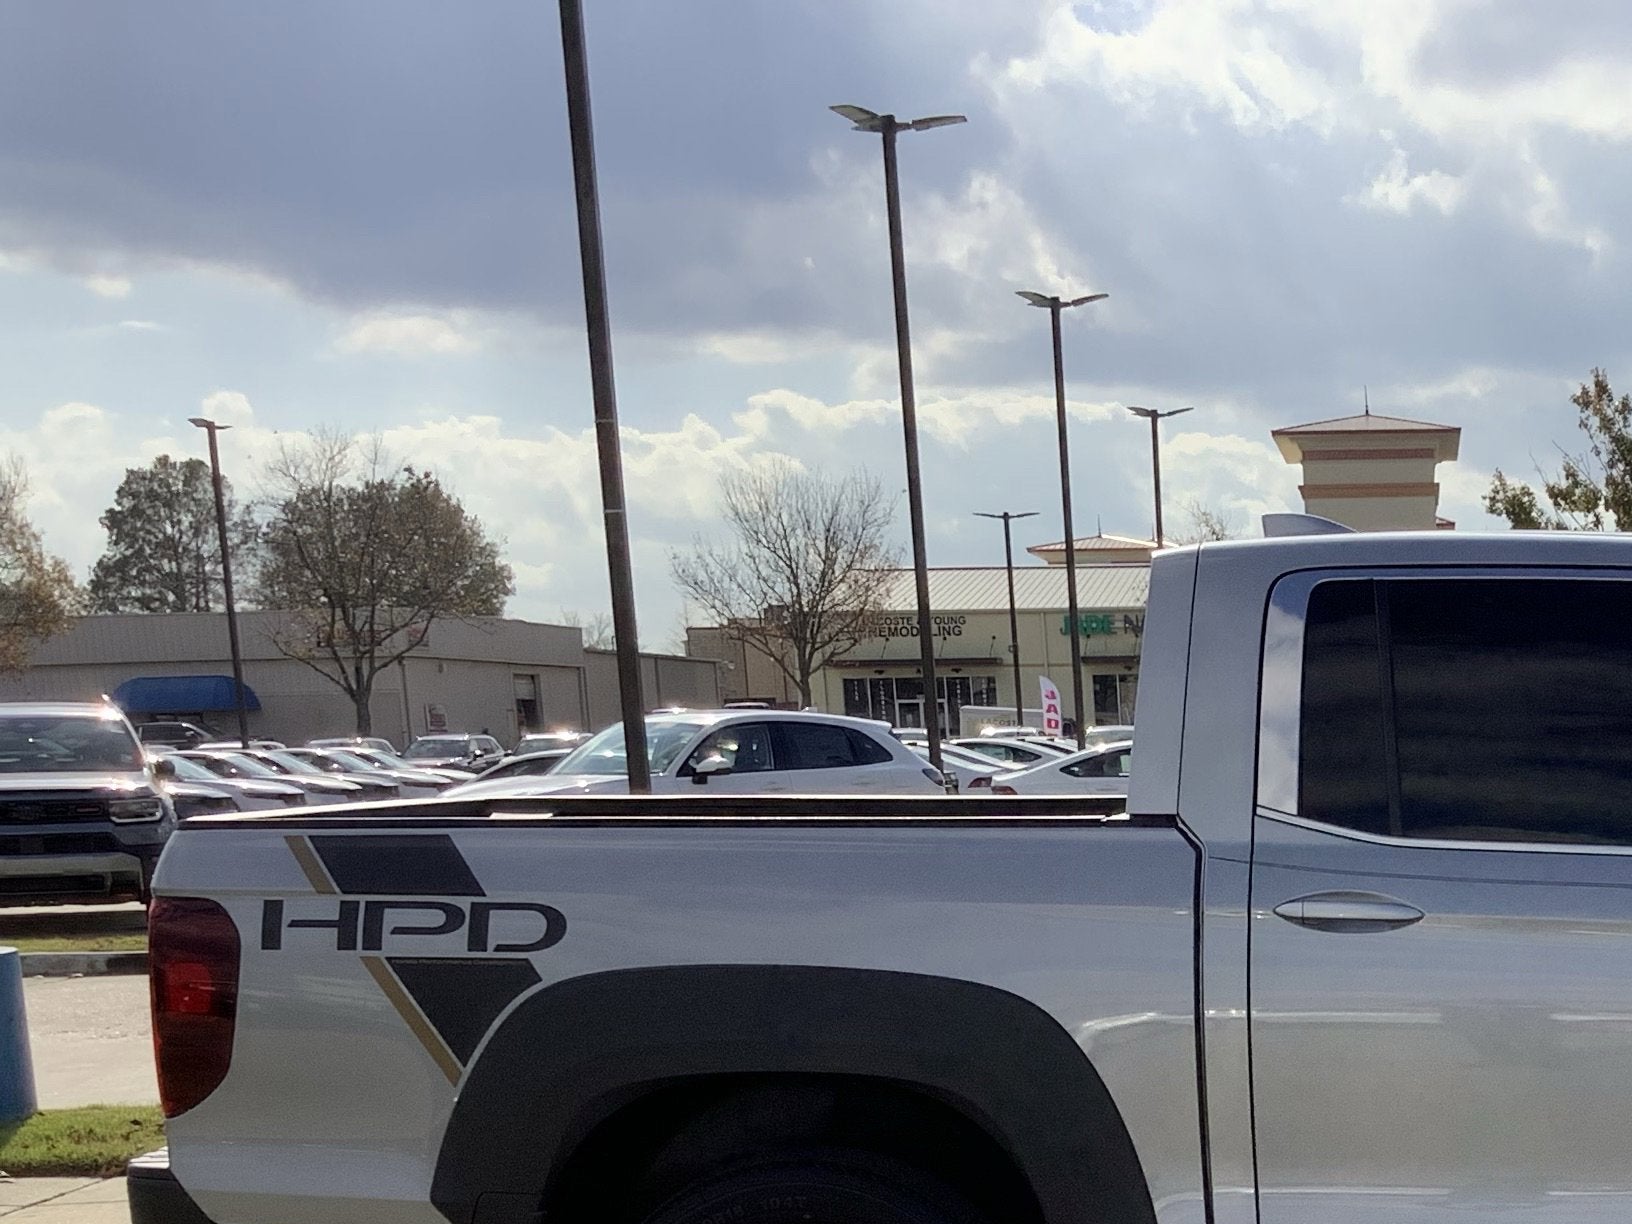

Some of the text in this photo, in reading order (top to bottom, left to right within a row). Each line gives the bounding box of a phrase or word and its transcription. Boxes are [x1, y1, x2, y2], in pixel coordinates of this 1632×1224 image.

[931, 615, 967, 626] OUNG
[868, 625, 963, 637] REMODLING
[261, 900, 567, 952] HPD
